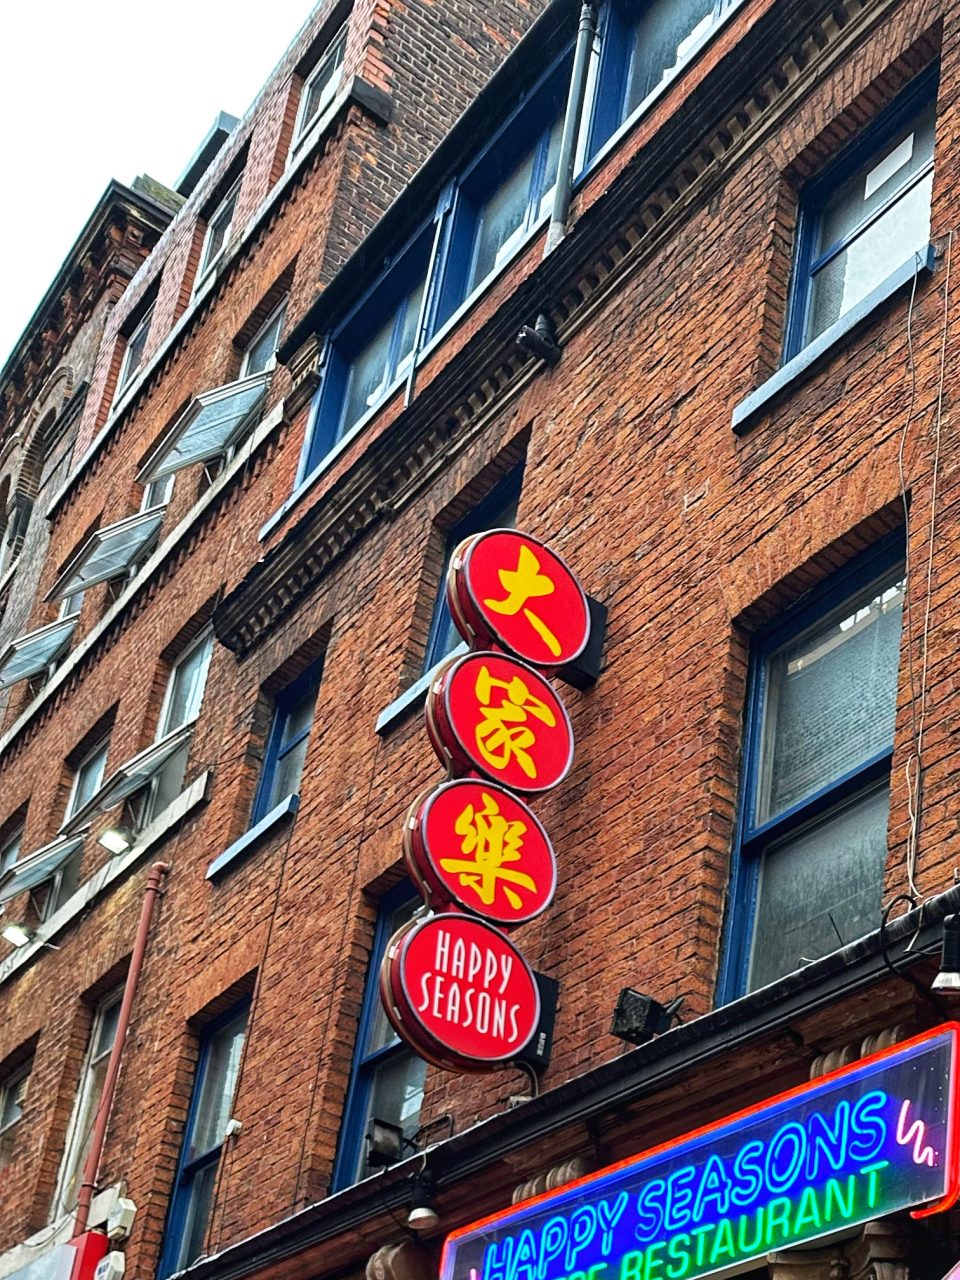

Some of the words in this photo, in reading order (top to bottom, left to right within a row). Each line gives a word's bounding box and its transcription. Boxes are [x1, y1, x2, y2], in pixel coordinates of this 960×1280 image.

[434, 930, 513, 993] HAPPY
[418, 971, 521, 1044] SEASONS
[635, 1090, 889, 1243] SEASONS
